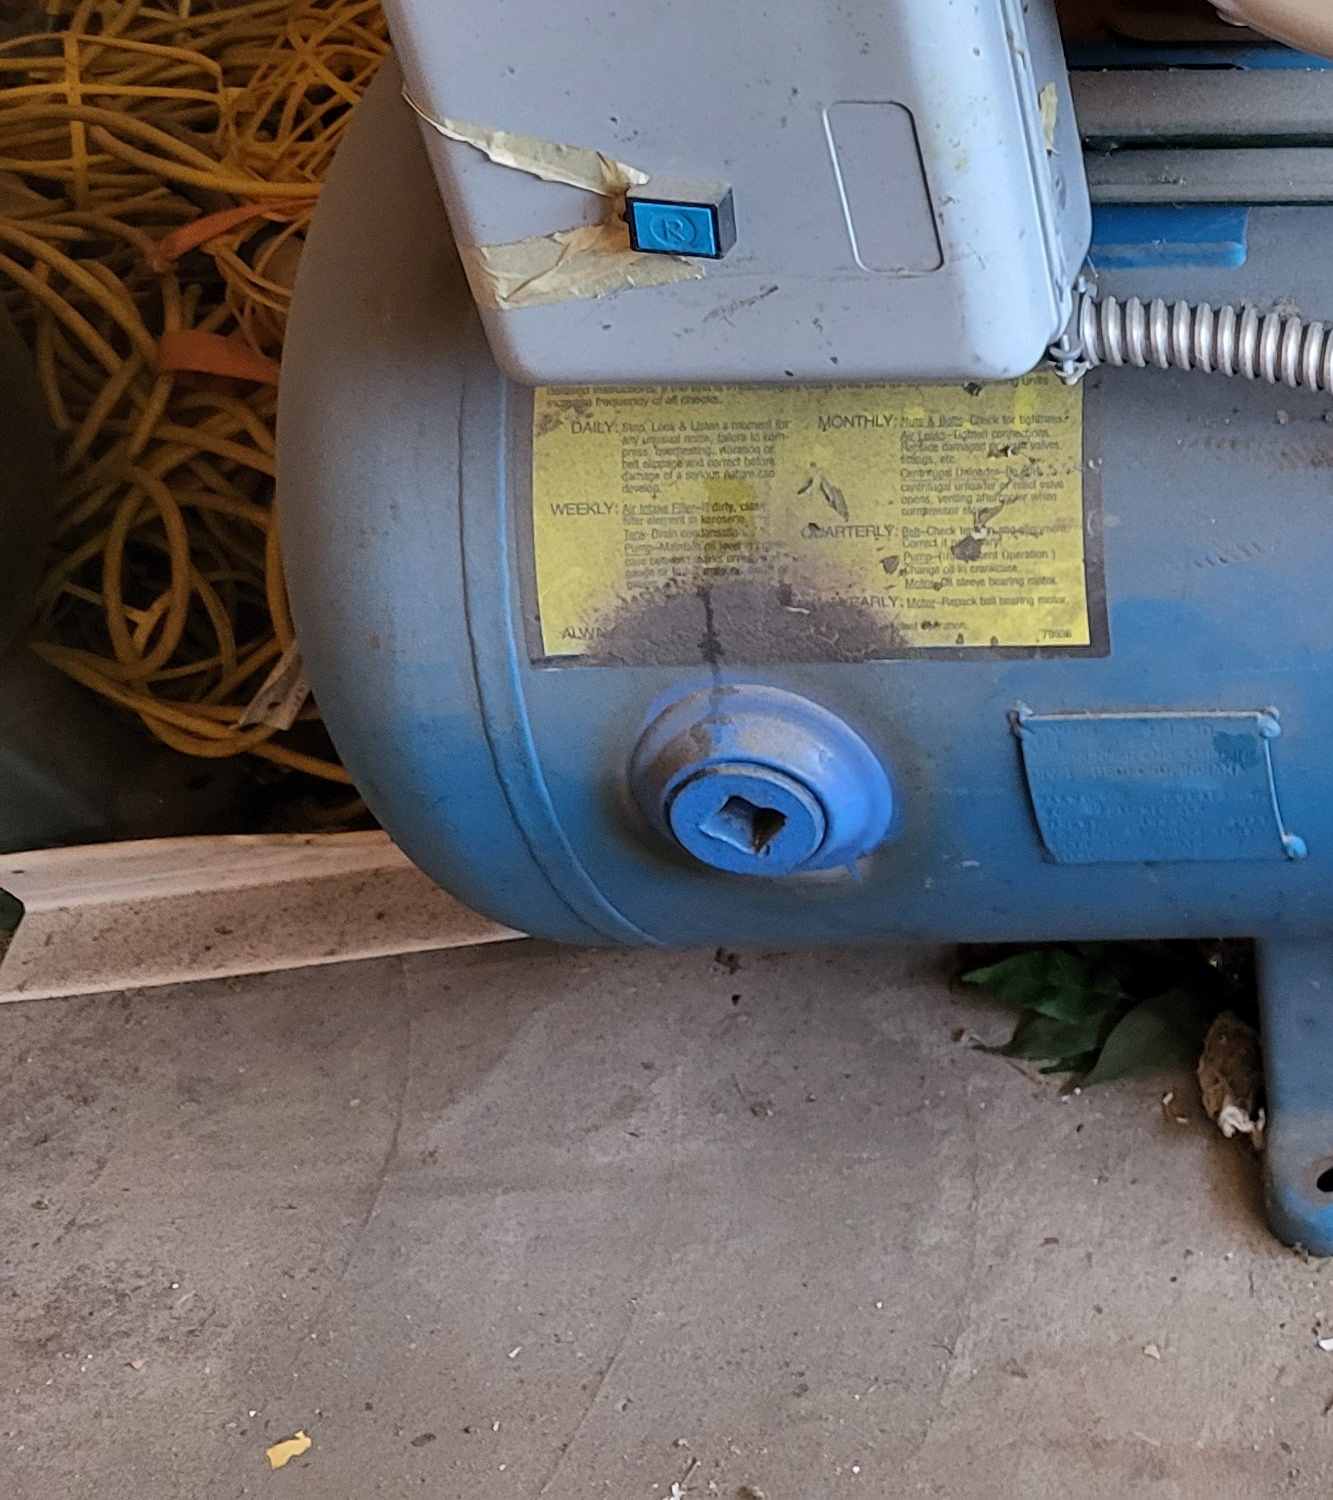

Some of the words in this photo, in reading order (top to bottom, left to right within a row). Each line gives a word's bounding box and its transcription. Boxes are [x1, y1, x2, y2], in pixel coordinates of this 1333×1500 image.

[571, 420, 619, 435] DAILY:
[817, 413, 900, 430] MONTHLY:
[550, 501, 619, 516] WEEKLY:
[801, 523, 900, 539] QUARTERLY:
